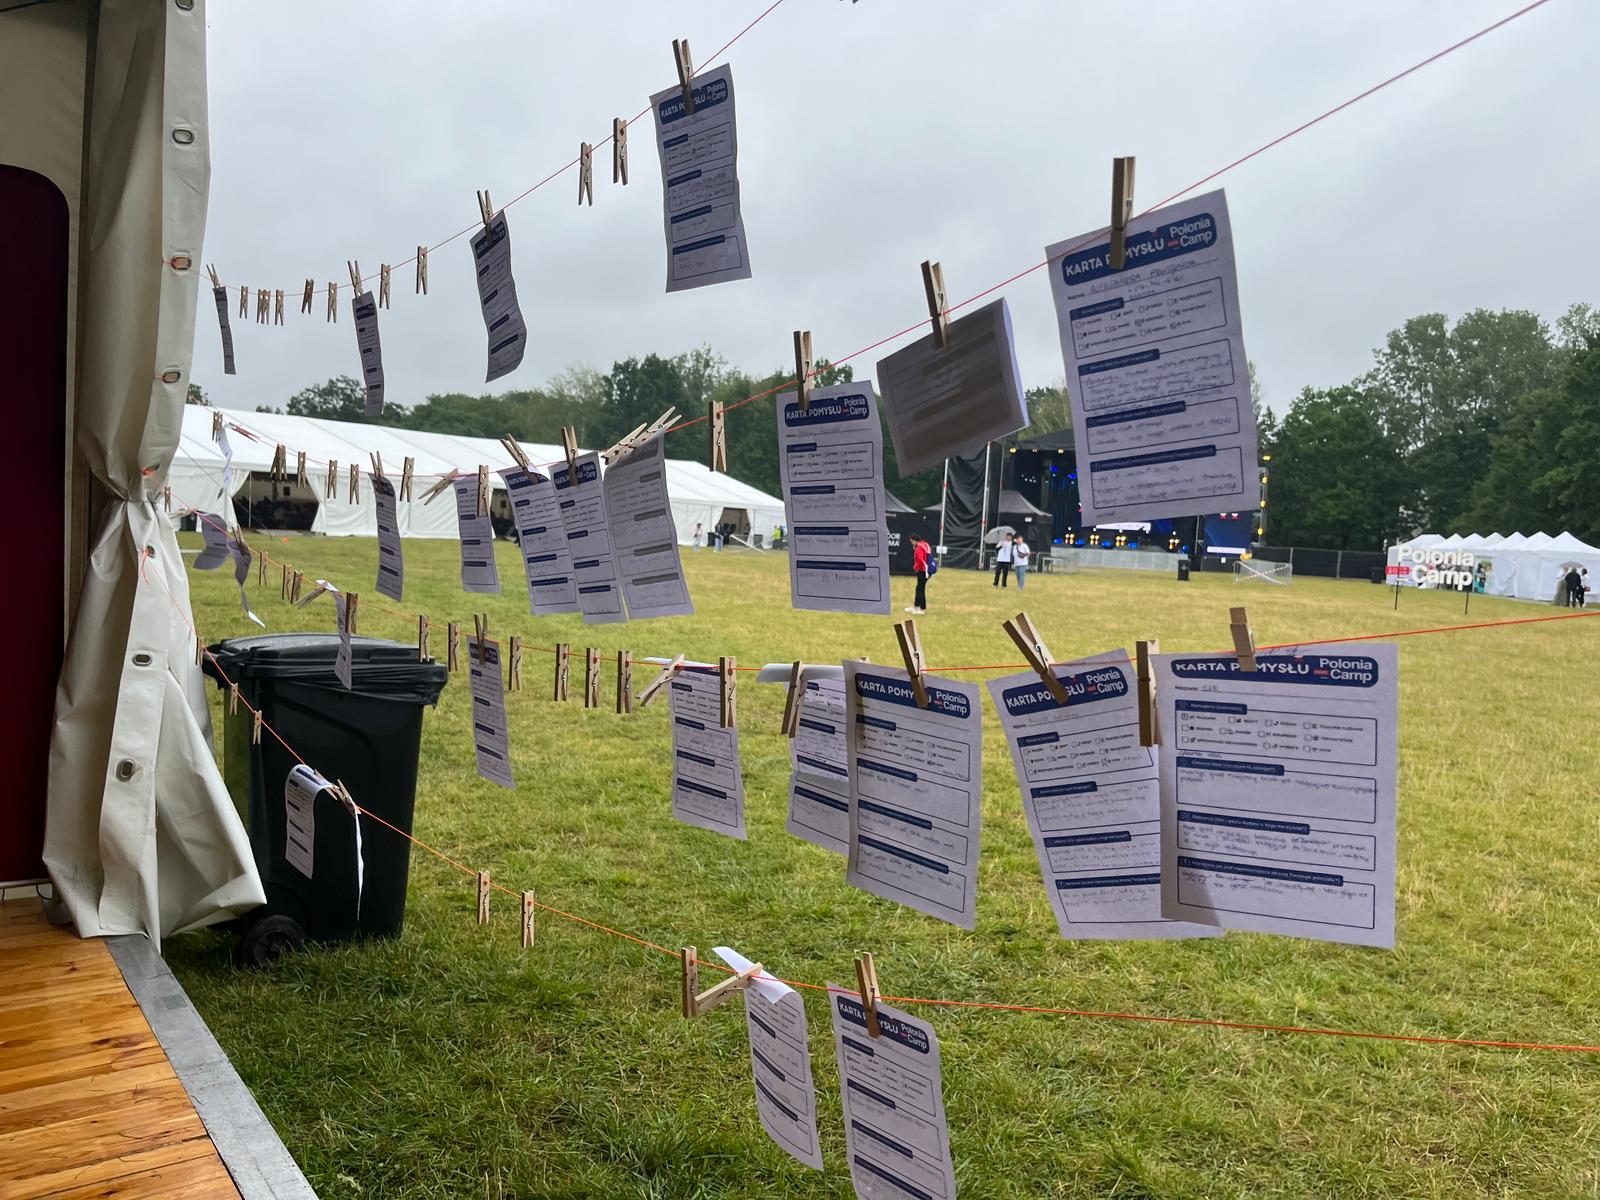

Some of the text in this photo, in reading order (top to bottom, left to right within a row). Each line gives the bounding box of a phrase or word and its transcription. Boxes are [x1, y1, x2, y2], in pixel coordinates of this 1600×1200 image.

[1170, 217, 1211, 238] Polonia
[1180, 230, 1213, 249] Camp
[1065, 258, 1103, 277] KARTA
[844, 397, 866, 407] Polonia
[786, 405, 842, 420] KARTA POMYSŁU
[849, 406, 868, 416] Camp
[1398, 544, 1471, 564] Polonia
[1412, 565, 1472, 590] Camp
[1175, 662, 1310, 675] KARTA PMYSŁU
[1319, 658, 1373, 670] Polonia
[1086, 670, 1120, 685] Polonia
[1330, 669, 1372, 684] Camp
[858, 680, 932, 702] KARTA POMY
[1097, 681, 1124, 694] Camp
[936, 691, 967, 704] Polonia
[1006, 693, 1037, 708] KARTA
[943, 701, 968, 716] Camp
[839, 1002, 862, 1019] KARTA
[907, 1034, 927, 1049] Camp
